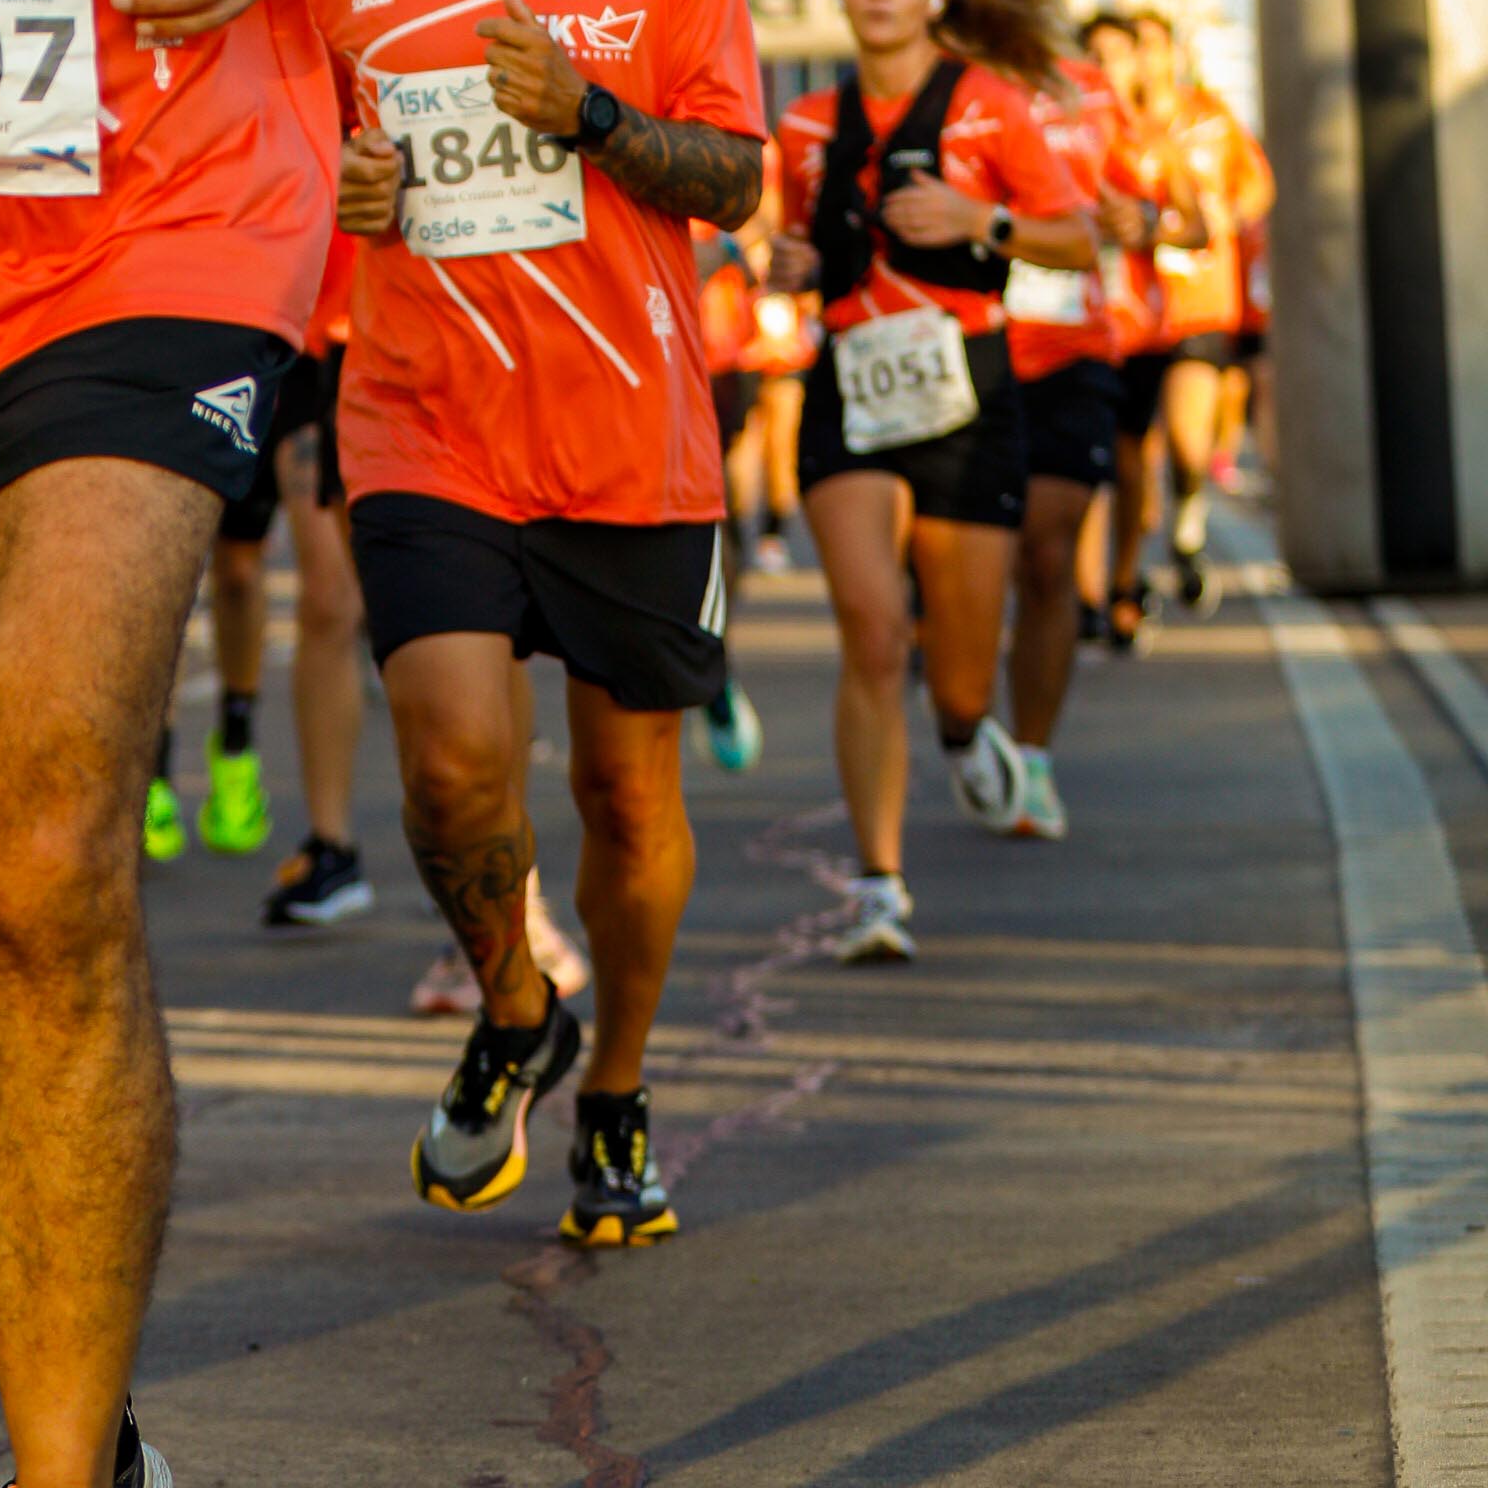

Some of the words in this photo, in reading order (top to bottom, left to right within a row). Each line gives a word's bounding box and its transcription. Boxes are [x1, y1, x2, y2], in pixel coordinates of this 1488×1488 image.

[394, 87, 442, 115] 15K
[394, 121, 567, 188] 1846
[419, 217, 476, 243] osde
[848, 348, 950, 405] 1051
[192, 401, 232, 433] NIKE
